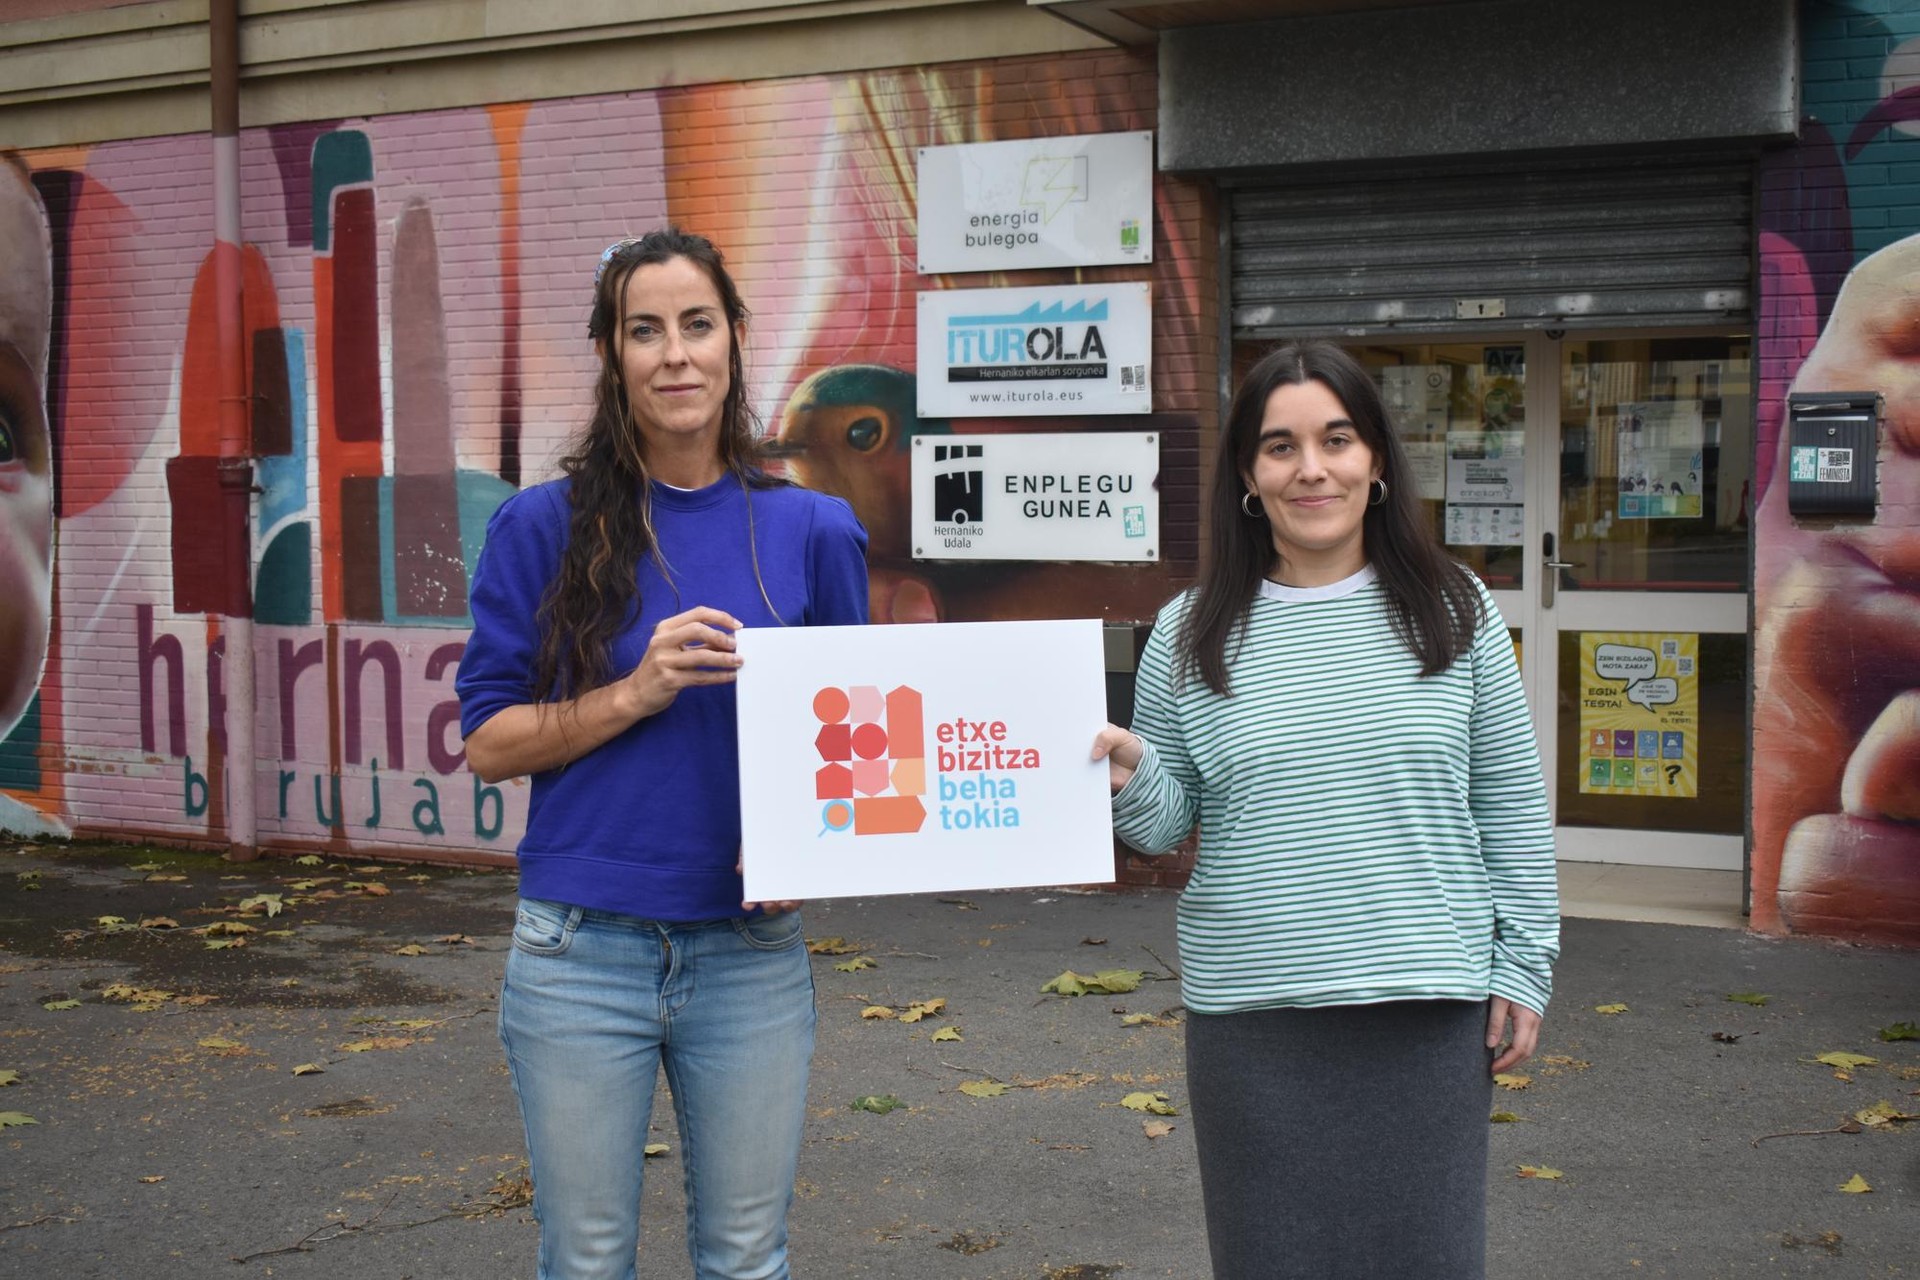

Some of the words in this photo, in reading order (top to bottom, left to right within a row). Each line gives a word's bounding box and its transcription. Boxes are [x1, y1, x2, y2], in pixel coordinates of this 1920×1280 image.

[970, 210, 1039, 229] energia
[965, 231, 1039, 249] bulegoa
[948, 325, 1107, 364] ITUROLA
[979, 368, 1025, 378] Hernaniko
[1026, 367, 1061, 377] elkarlan
[1062, 366, 1104, 377] sorgunea
[970, 390, 1084, 402] www.iturola.eus
[1005, 475, 1133, 493] ENPLEGU
[1023, 500, 1111, 518] GUNEA
[934, 526, 984, 536] Hernaniko
[944, 538, 972, 549] Udala
[1588, 687, 1617, 696] EGIN
[1583, 700, 1622, 708] TESTA!
[936, 717, 1007, 743] etxe
[937, 743, 1040, 772] bizitza
[938, 772, 1016, 801] beha
[939, 800, 1020, 830] tokia
